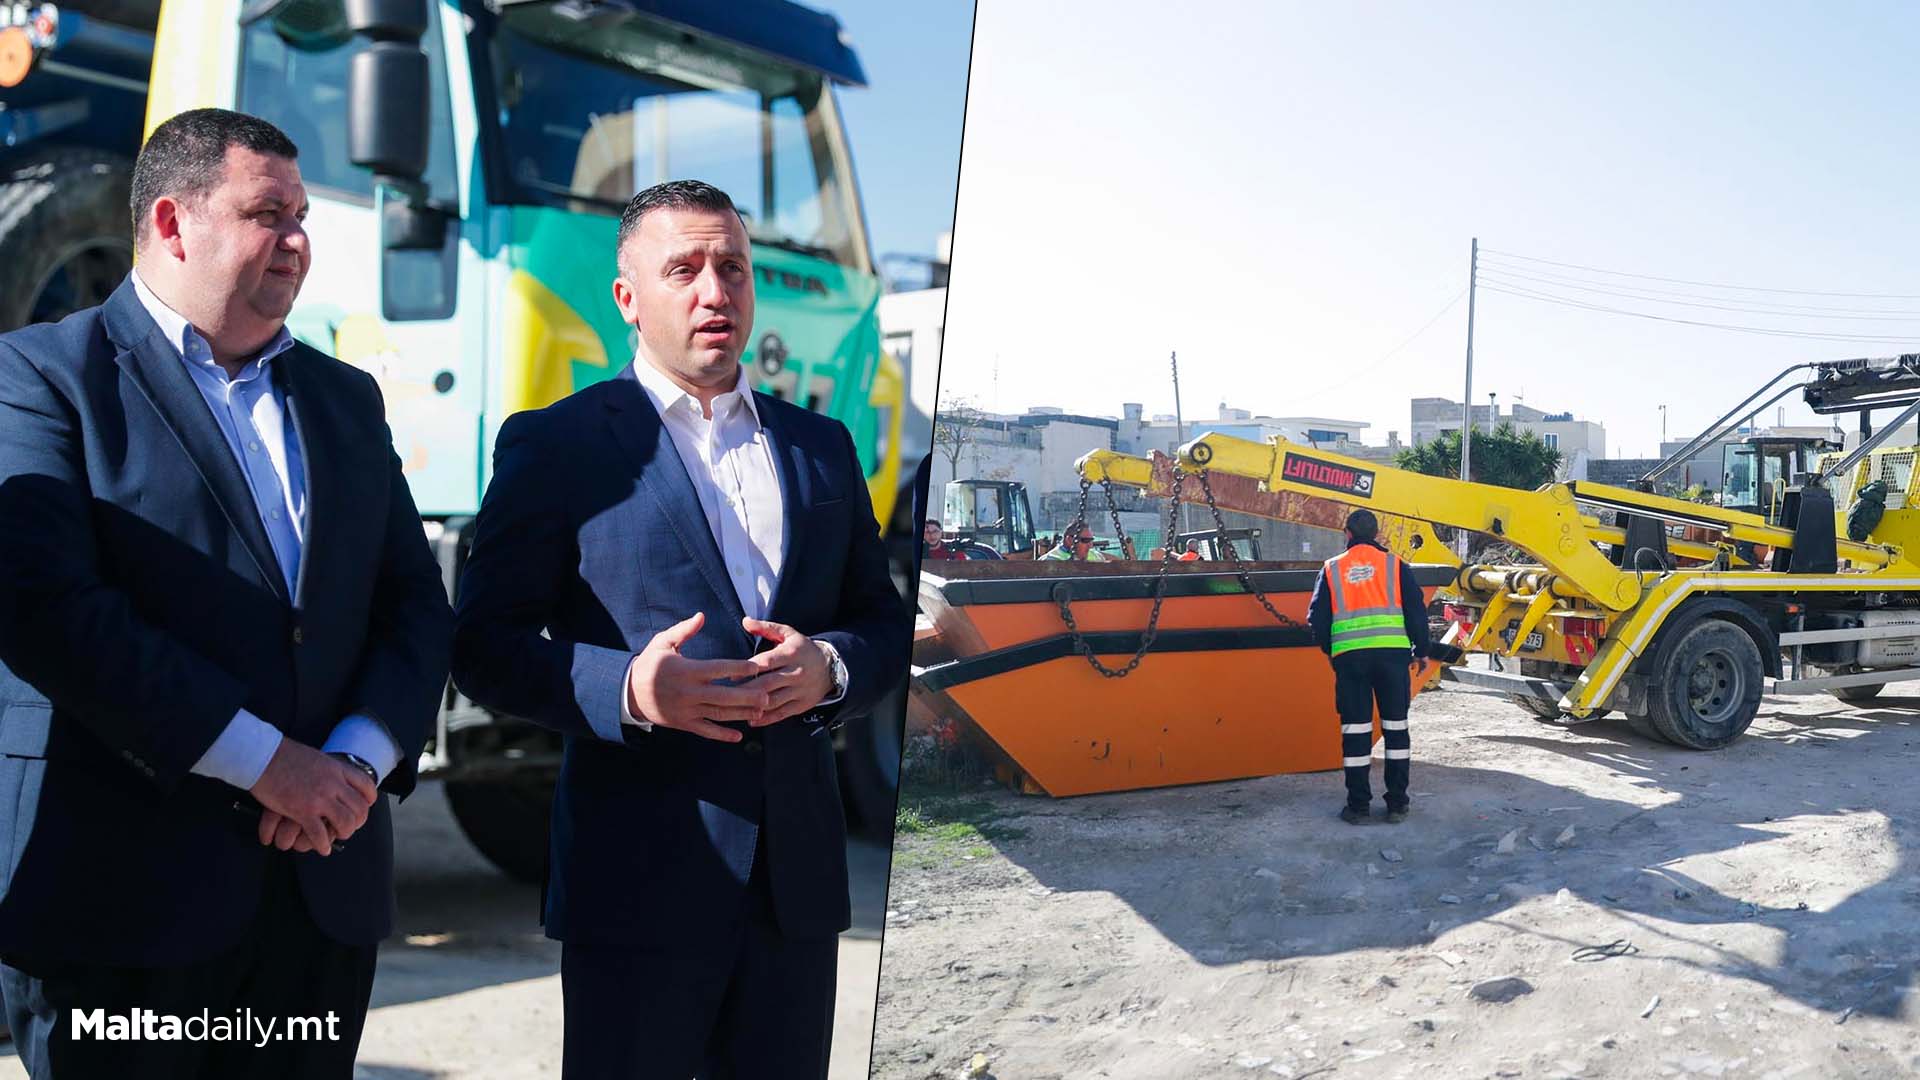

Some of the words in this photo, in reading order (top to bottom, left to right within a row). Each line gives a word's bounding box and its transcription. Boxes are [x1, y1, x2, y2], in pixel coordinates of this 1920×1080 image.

[754, 264, 829, 297] TRA
[1284, 456, 1354, 489] MULTILIFT
[1664, 524, 1686, 539] SE
